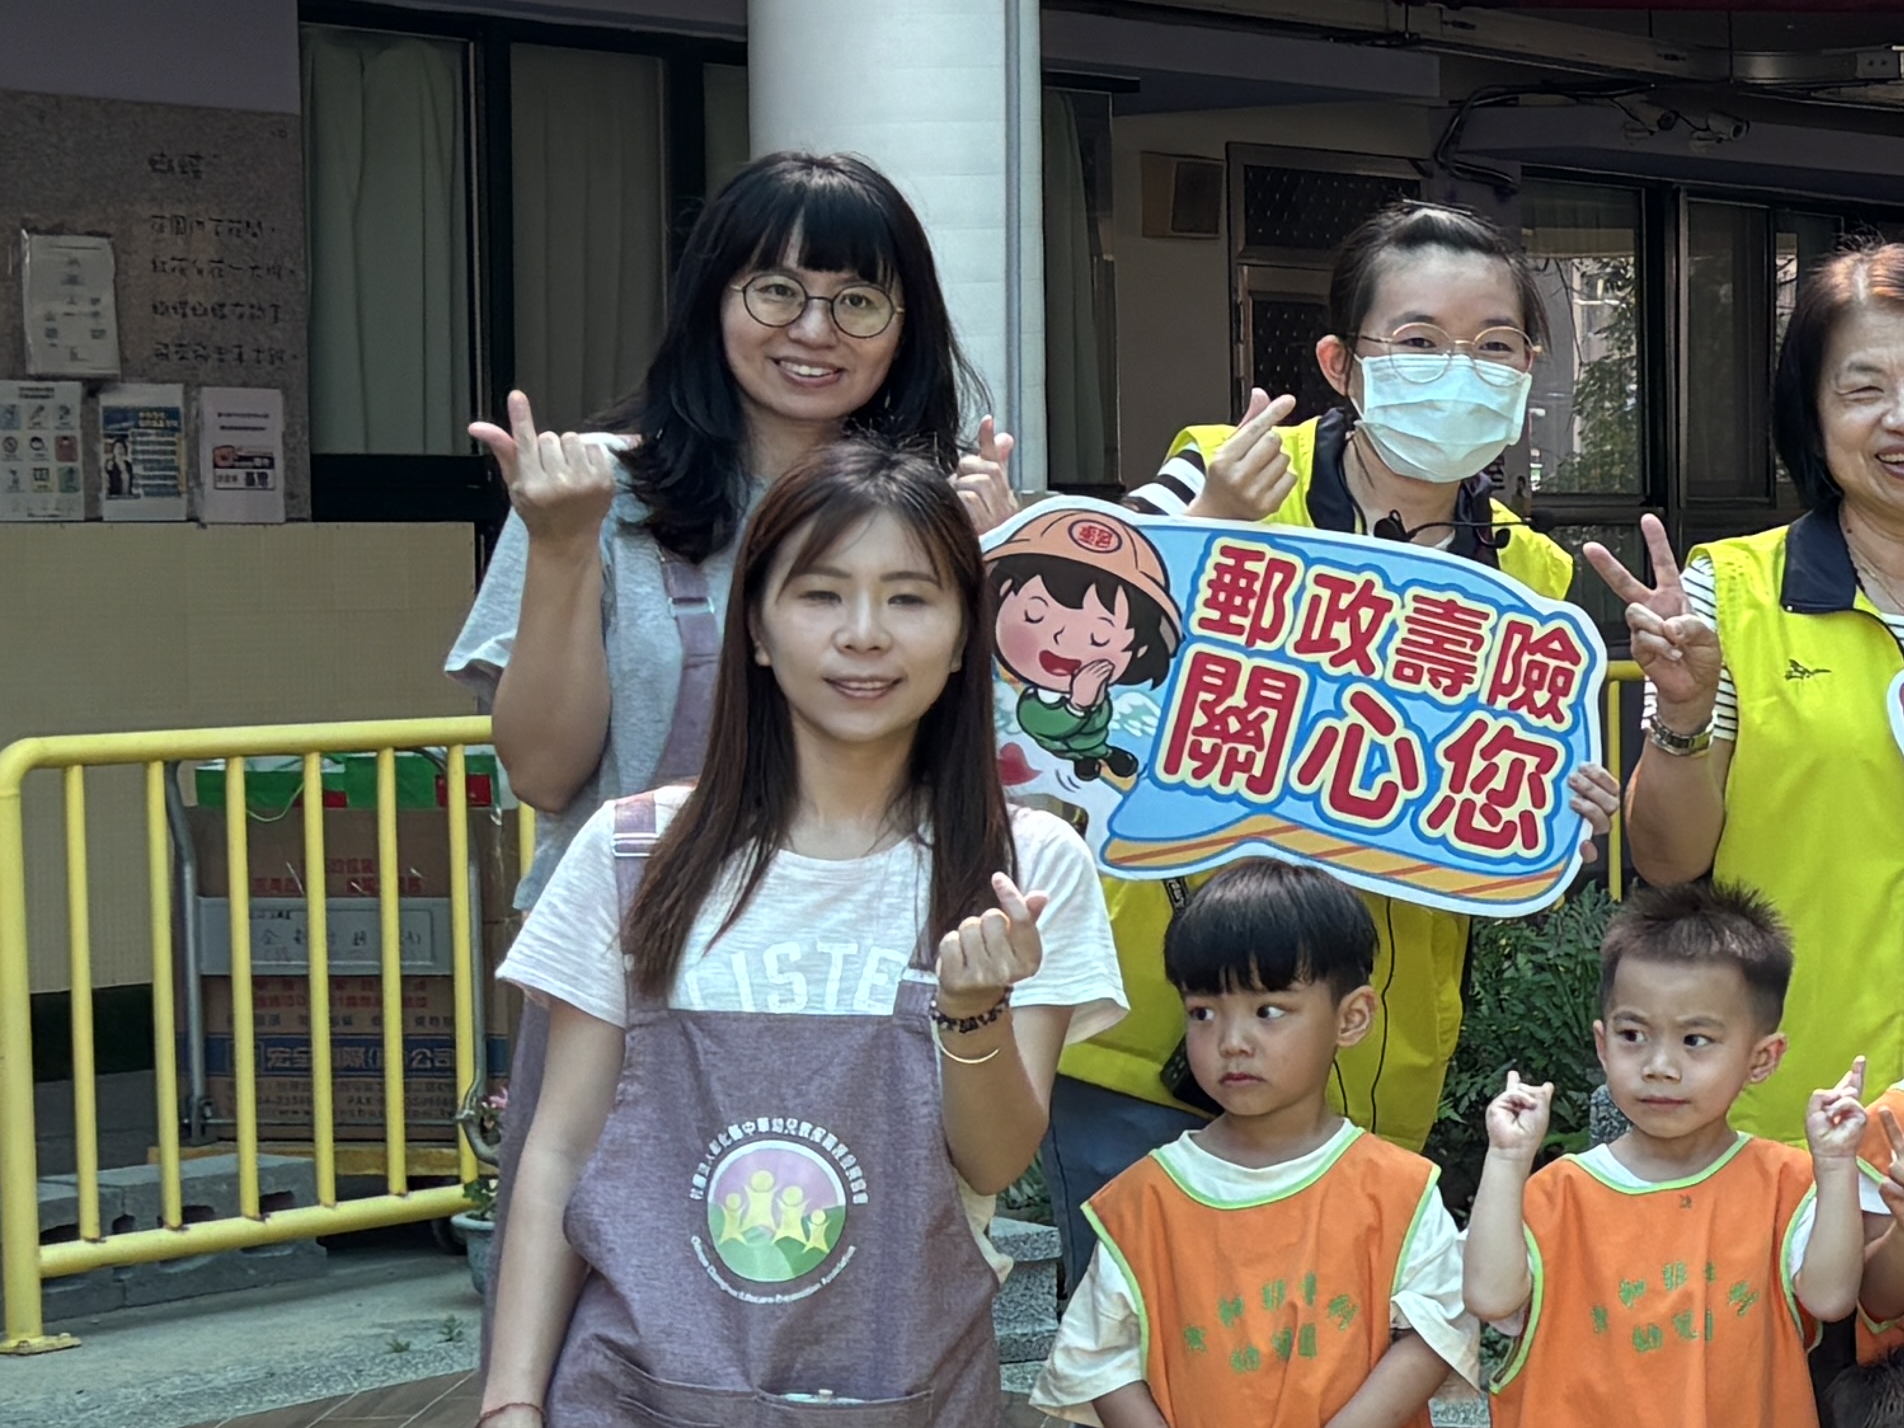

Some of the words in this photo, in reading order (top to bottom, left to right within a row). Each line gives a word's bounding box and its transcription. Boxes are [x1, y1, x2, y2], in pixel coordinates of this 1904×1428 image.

[1198, 545, 1584, 726] 郵政壽險
[1162, 653, 1559, 852] 關心您
